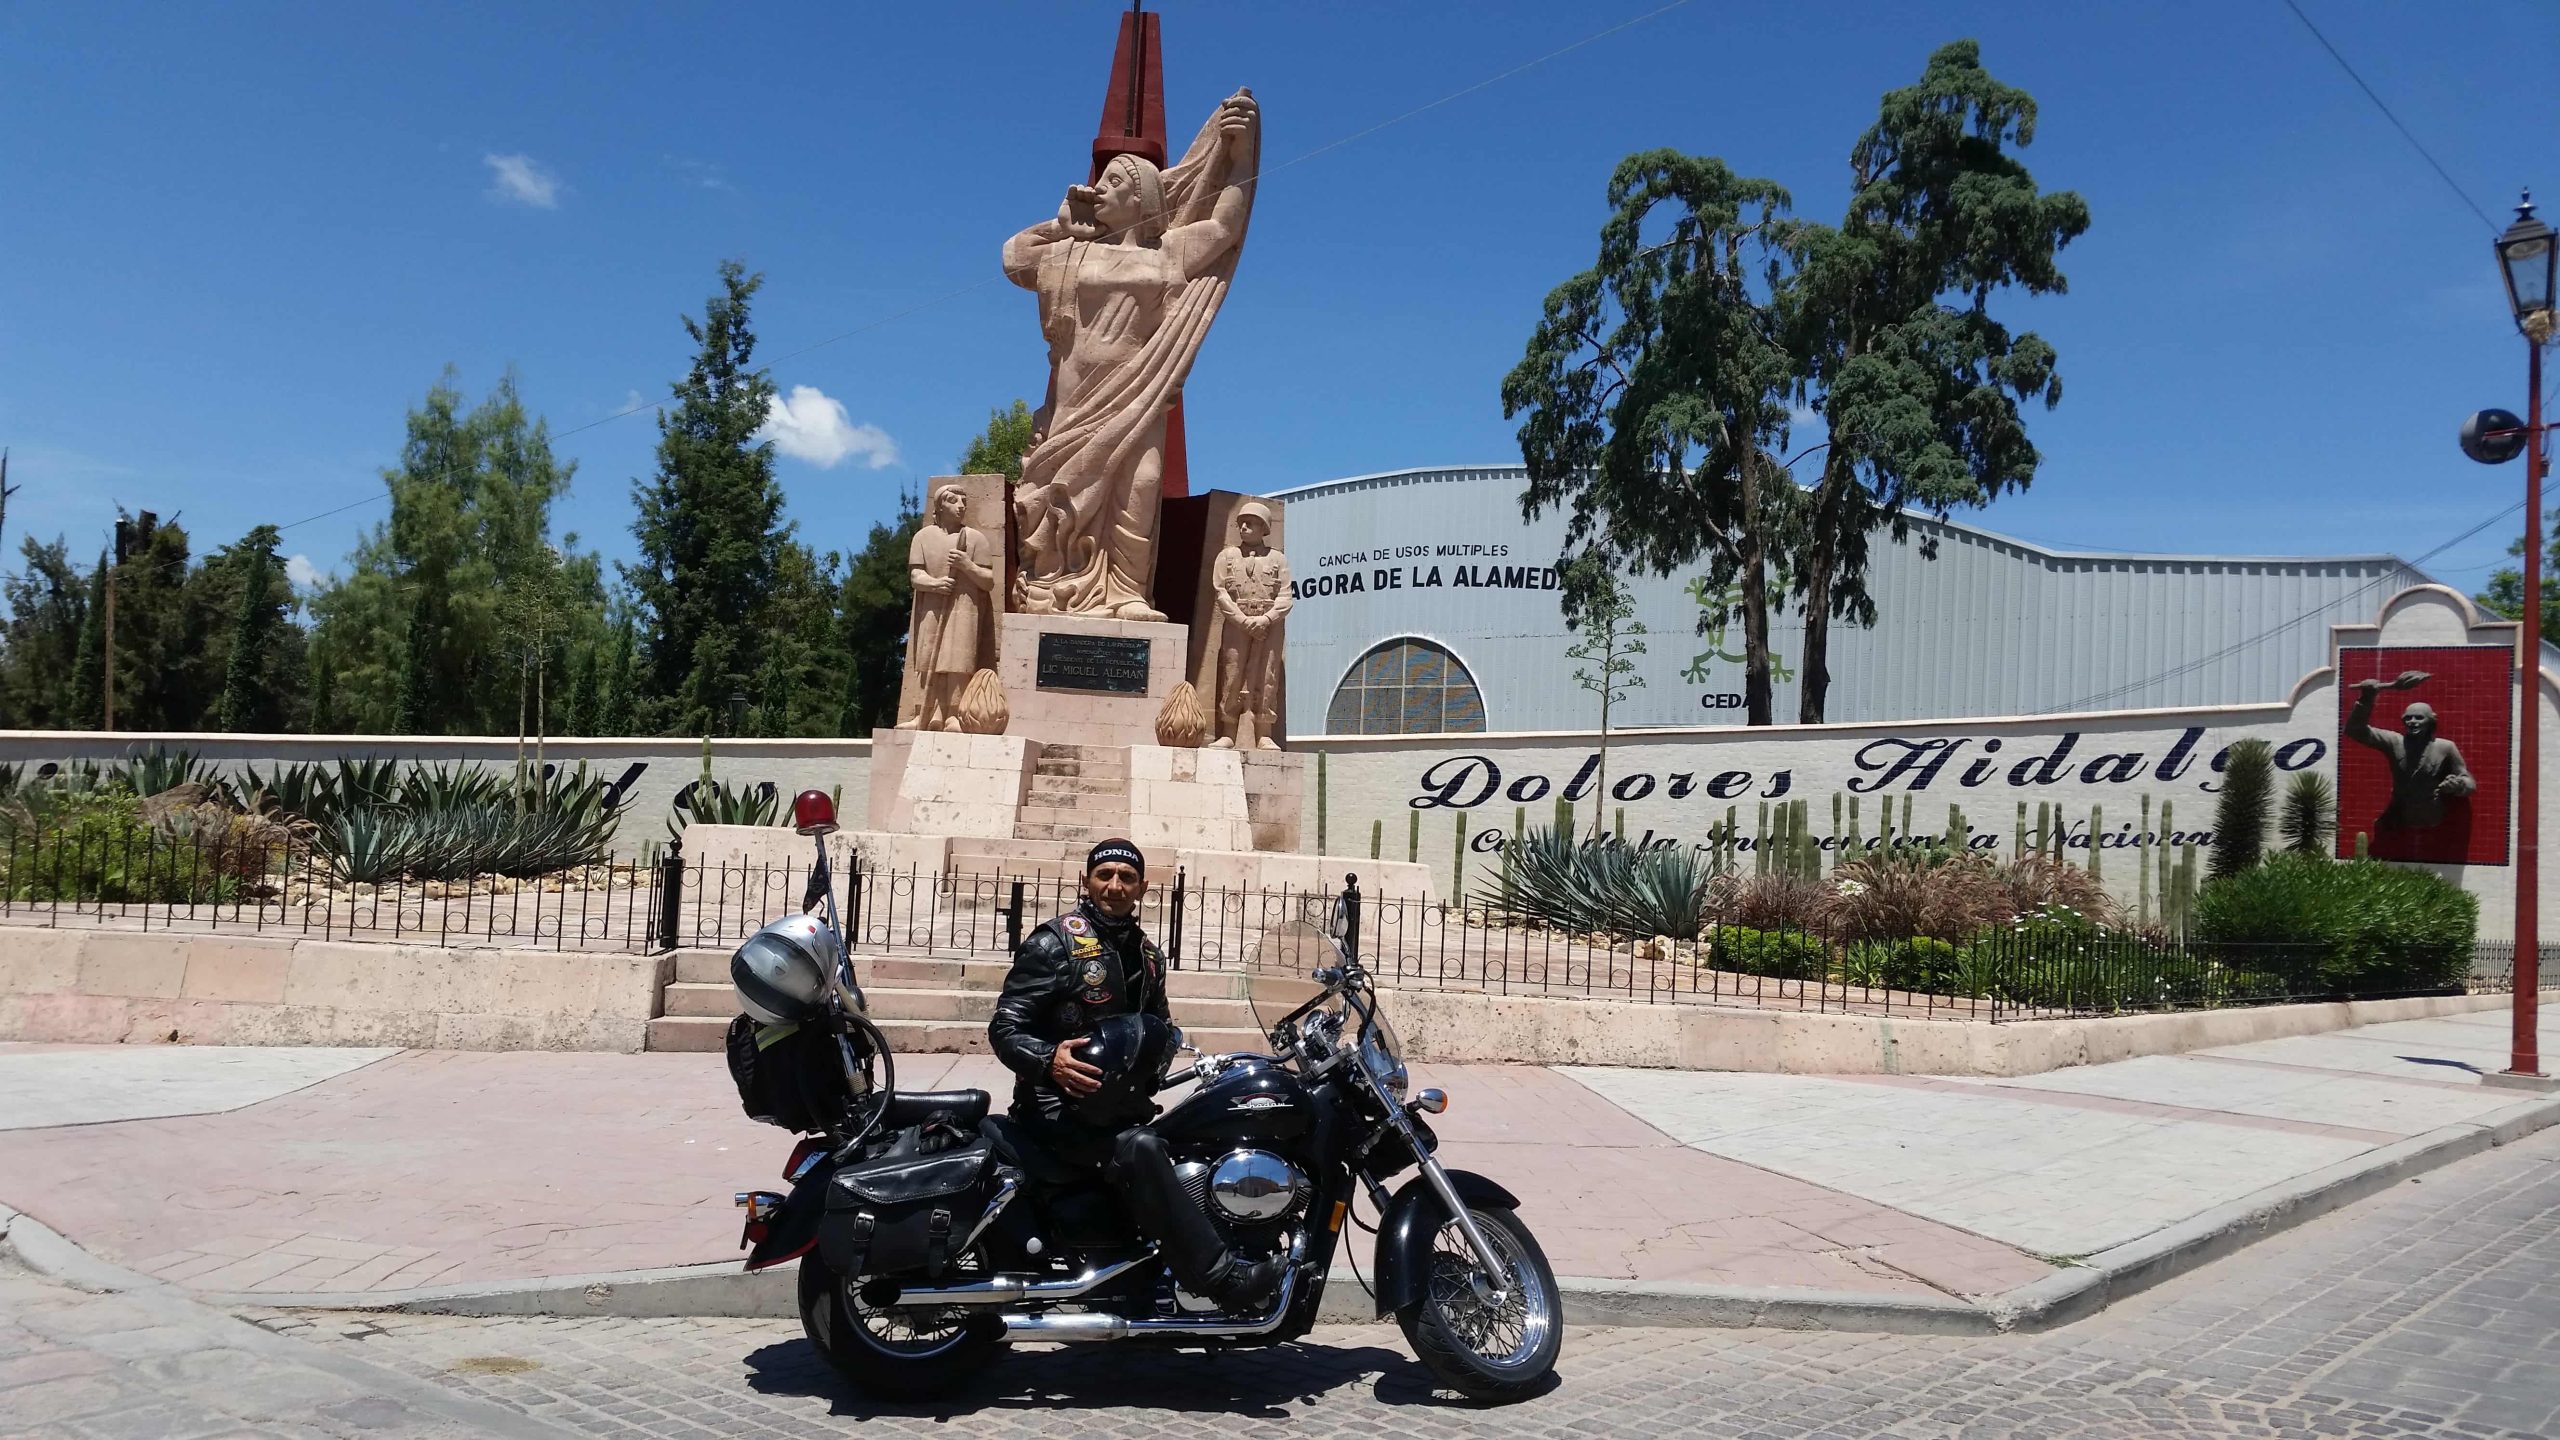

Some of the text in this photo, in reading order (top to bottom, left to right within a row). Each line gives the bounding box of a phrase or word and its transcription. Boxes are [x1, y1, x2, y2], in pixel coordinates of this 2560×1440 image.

[1319, 545, 1509, 567] CANCHA DE USOS MULTIPLES
[1290, 565, 1563, 600] AGORA DE LA ALAMED
[1063, 665, 1098, 676] MIGUEL
[1102, 668, 1145, 680] ALEMAN
[1408, 754, 1792, 809] Dolores
[2025, 820, 2217, 853] Naciona
[1094, 848, 1139, 862] HONDA
[1071, 944, 1104, 956] HONDA
[1227, 1099, 1294, 1110] Shadow
